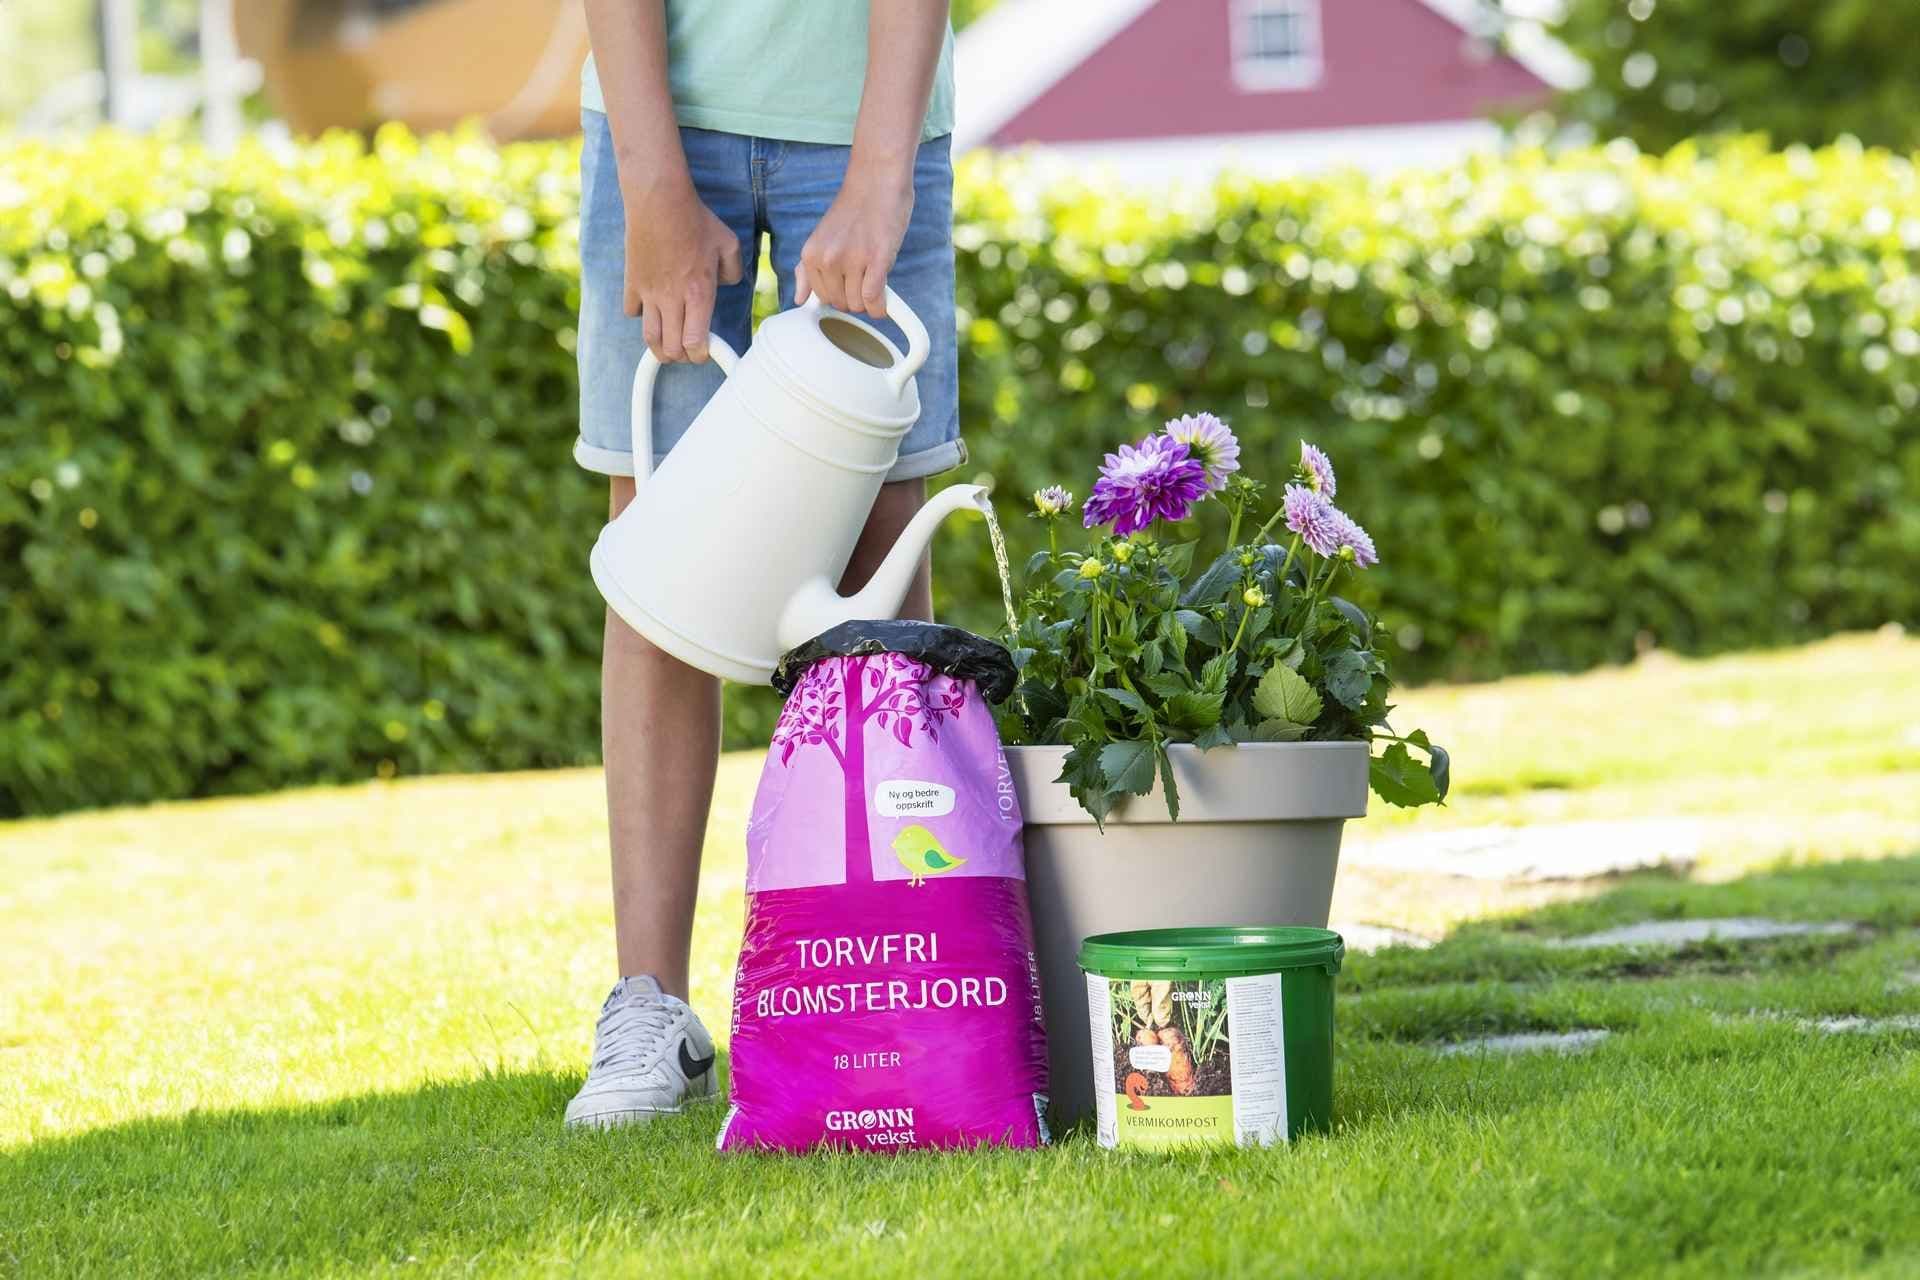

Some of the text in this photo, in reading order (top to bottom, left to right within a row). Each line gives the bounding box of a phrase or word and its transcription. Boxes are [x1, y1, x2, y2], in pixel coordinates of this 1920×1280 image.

[889, 789, 940, 799] Ny og bedre
[895, 800, 934, 811] oppskrift
[796, 932, 938, 969] TORVFRI
[1028, 951, 1041, 999] LITER
[757, 977, 1008, 1018] BLOMSTERJORD
[833, 1052, 901, 1070] 18 LITER
[1126, 1115, 1219, 1128] VERMIKOMPOST
[865, 1129, 917, 1145] vekst
